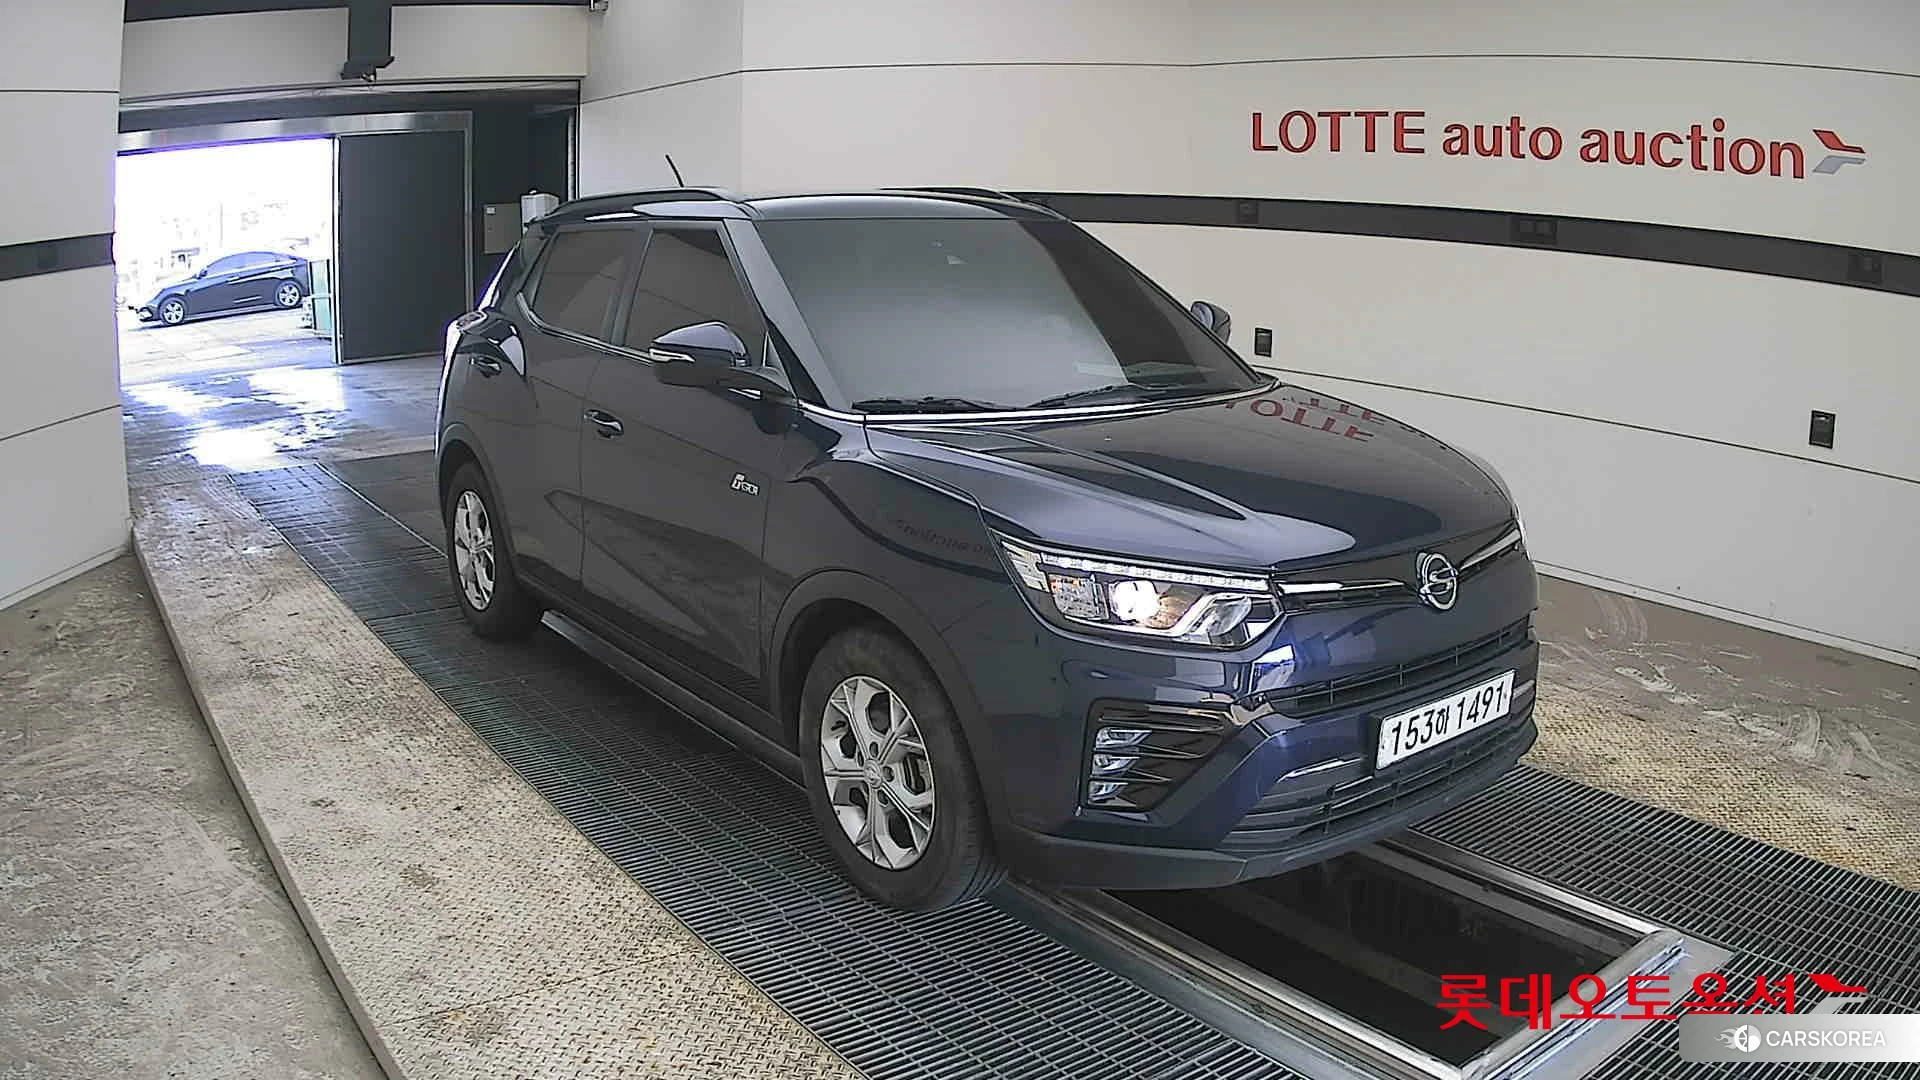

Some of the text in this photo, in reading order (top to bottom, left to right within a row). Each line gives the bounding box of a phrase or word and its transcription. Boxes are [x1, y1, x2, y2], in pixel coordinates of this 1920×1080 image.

[1251, 110, 1806, 179] LOTTE auto auction
[1391, 680, 1505, 756] 153하 1491
